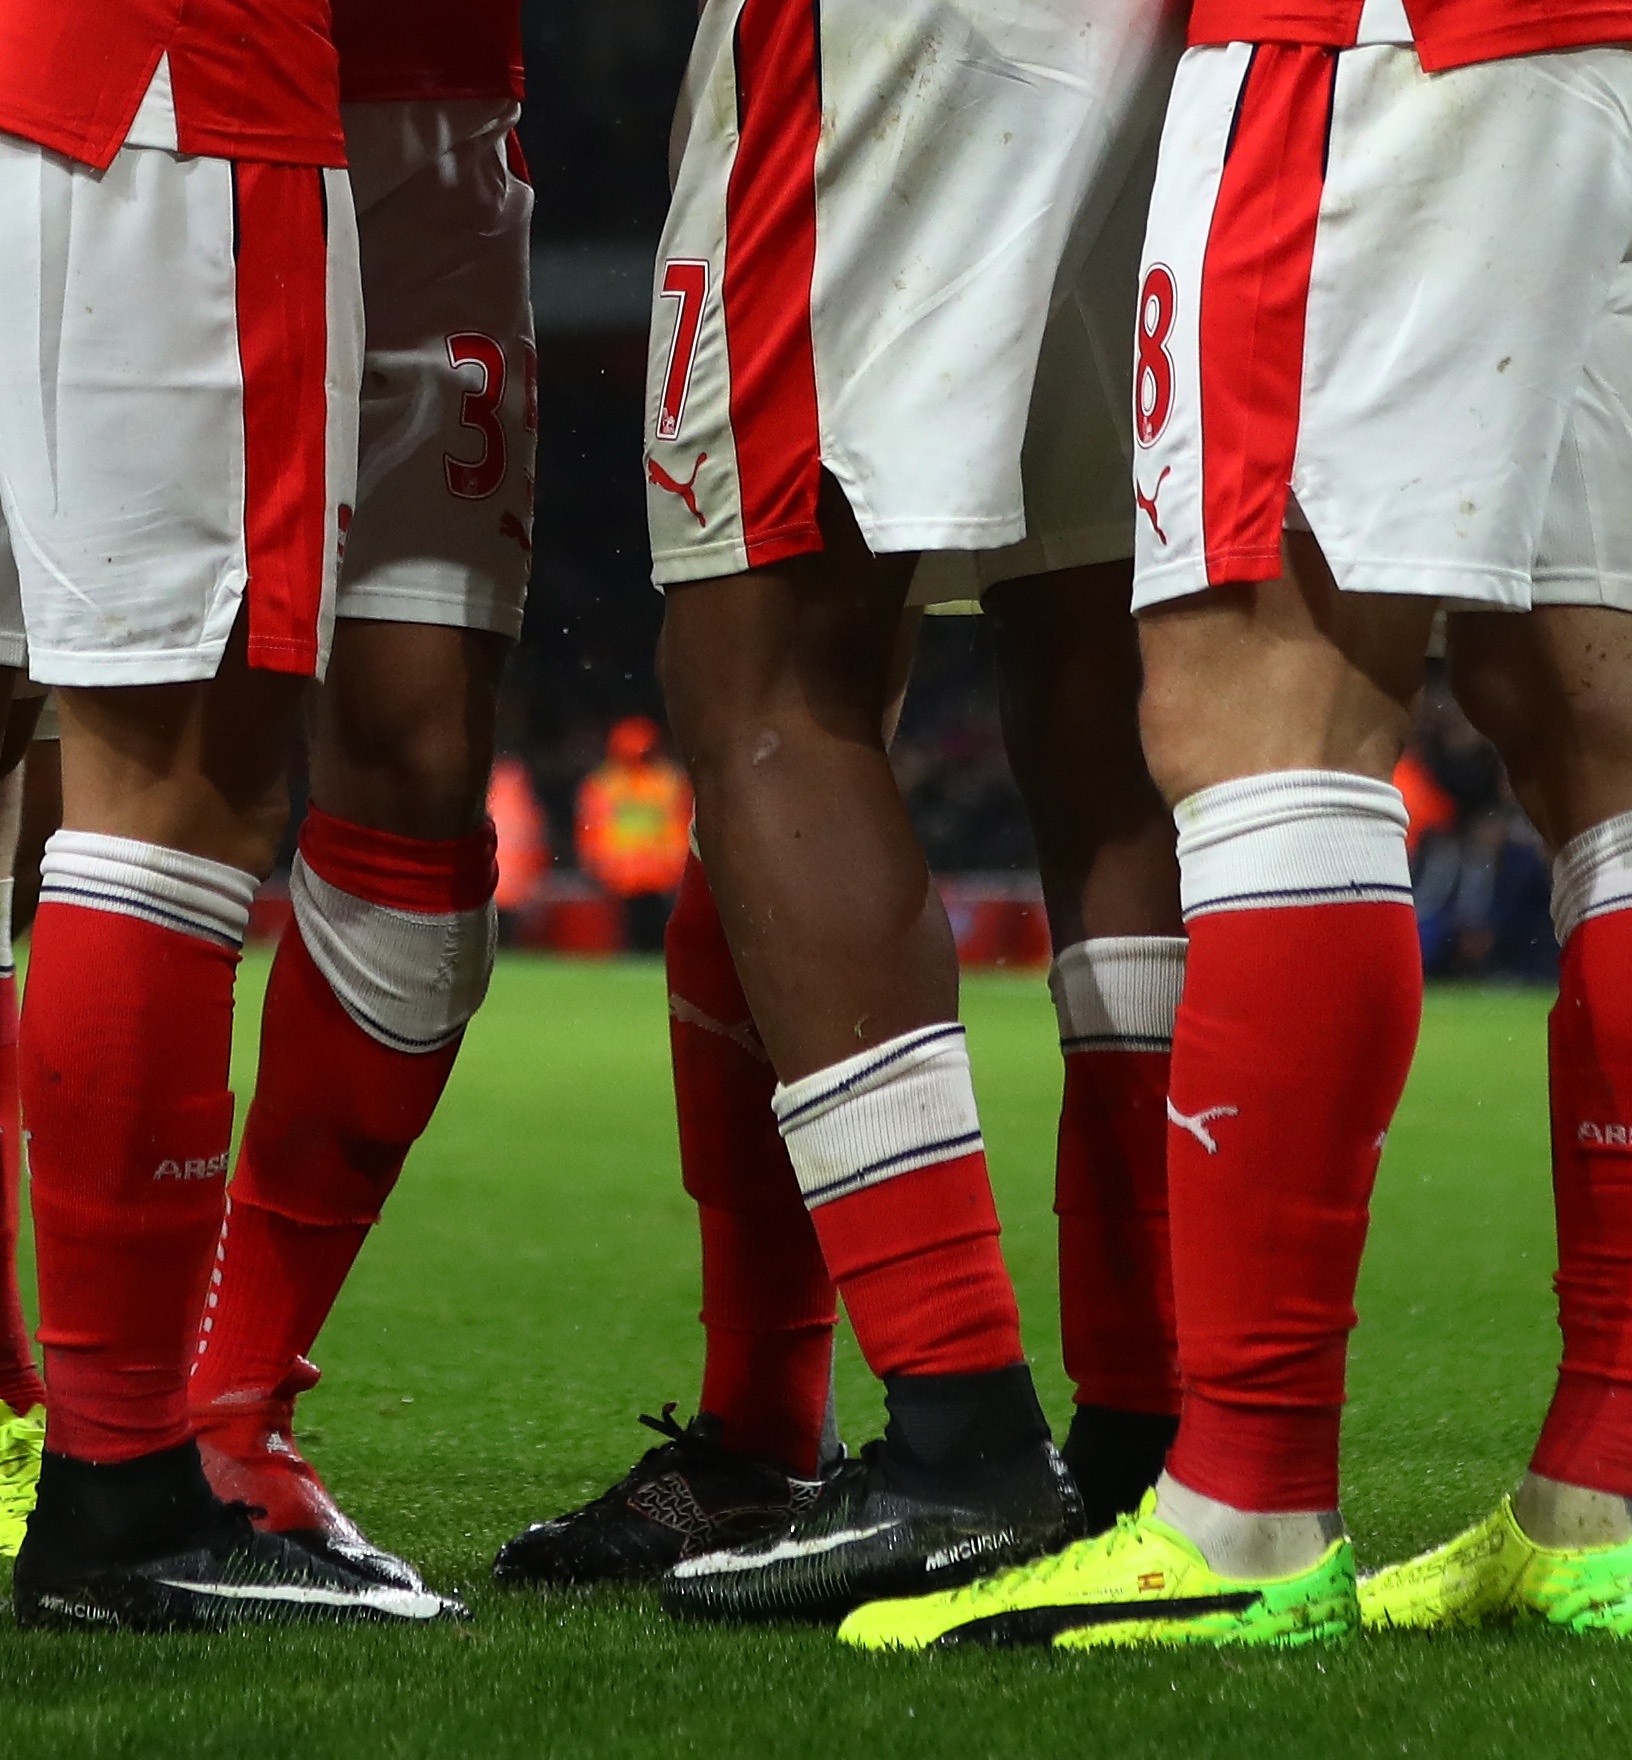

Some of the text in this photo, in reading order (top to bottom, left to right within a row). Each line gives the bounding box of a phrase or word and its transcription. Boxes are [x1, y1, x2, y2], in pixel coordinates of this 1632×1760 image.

[443, 331, 538, 500] 3
[659, 257, 710, 441] 7
[1135, 262, 1179, 450] 8
